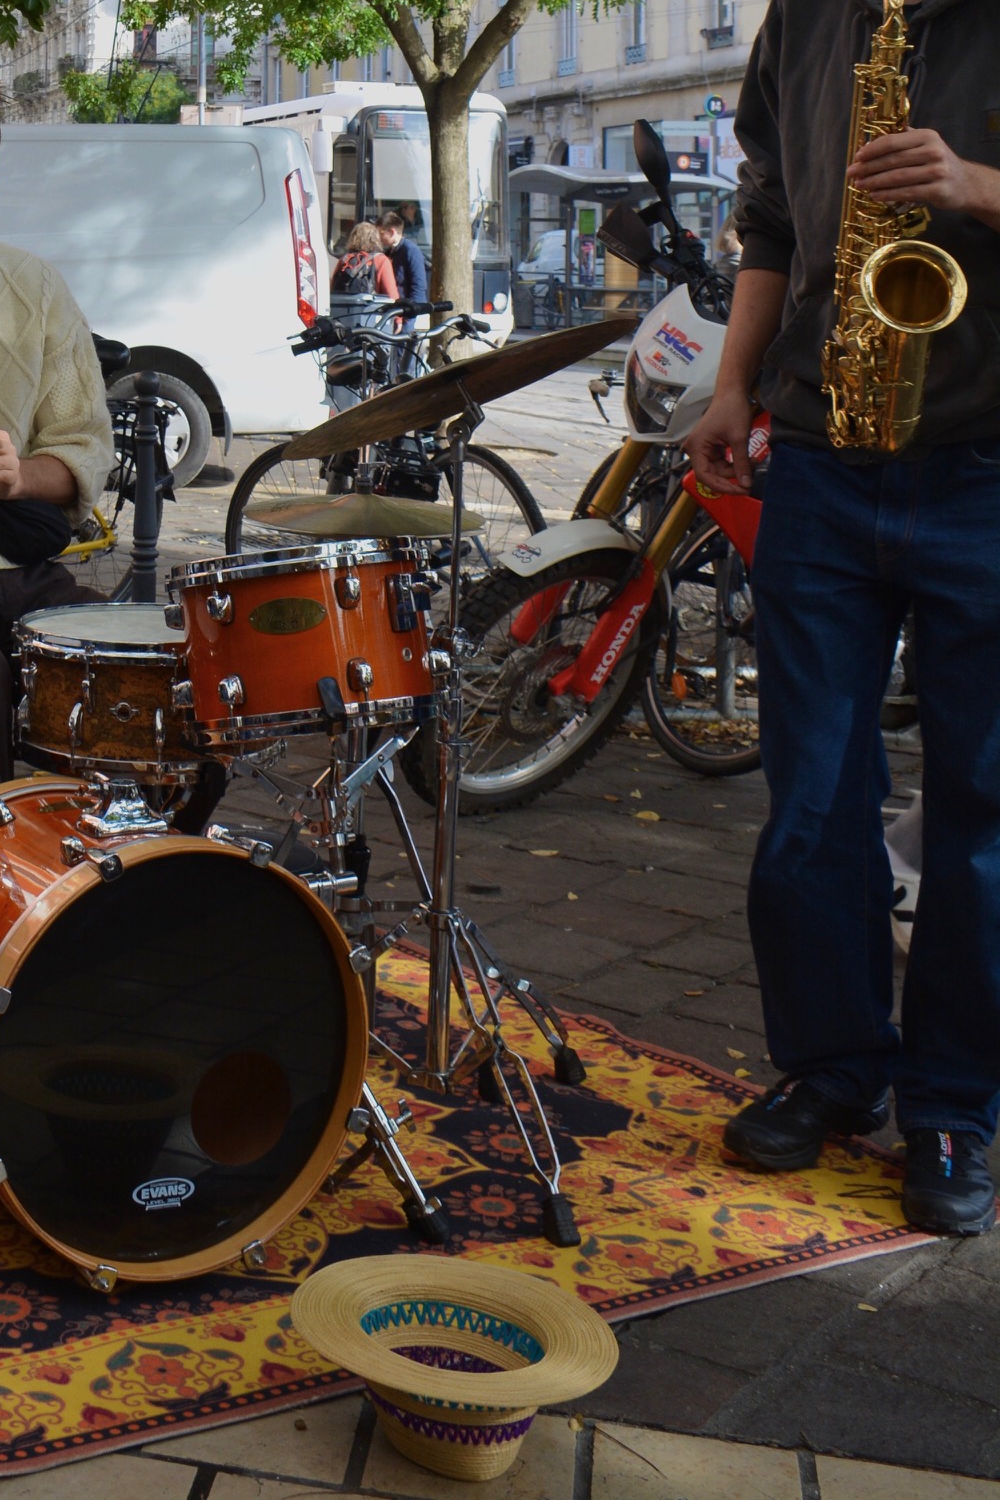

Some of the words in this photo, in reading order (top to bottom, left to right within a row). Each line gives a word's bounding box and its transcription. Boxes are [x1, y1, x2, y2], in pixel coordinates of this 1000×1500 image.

[655, 322, 703, 362] HRC
[669, 347, 690, 366] RACING
[590, 602, 646, 685] HONDA
[141, 1184, 187, 1200] EVANS
